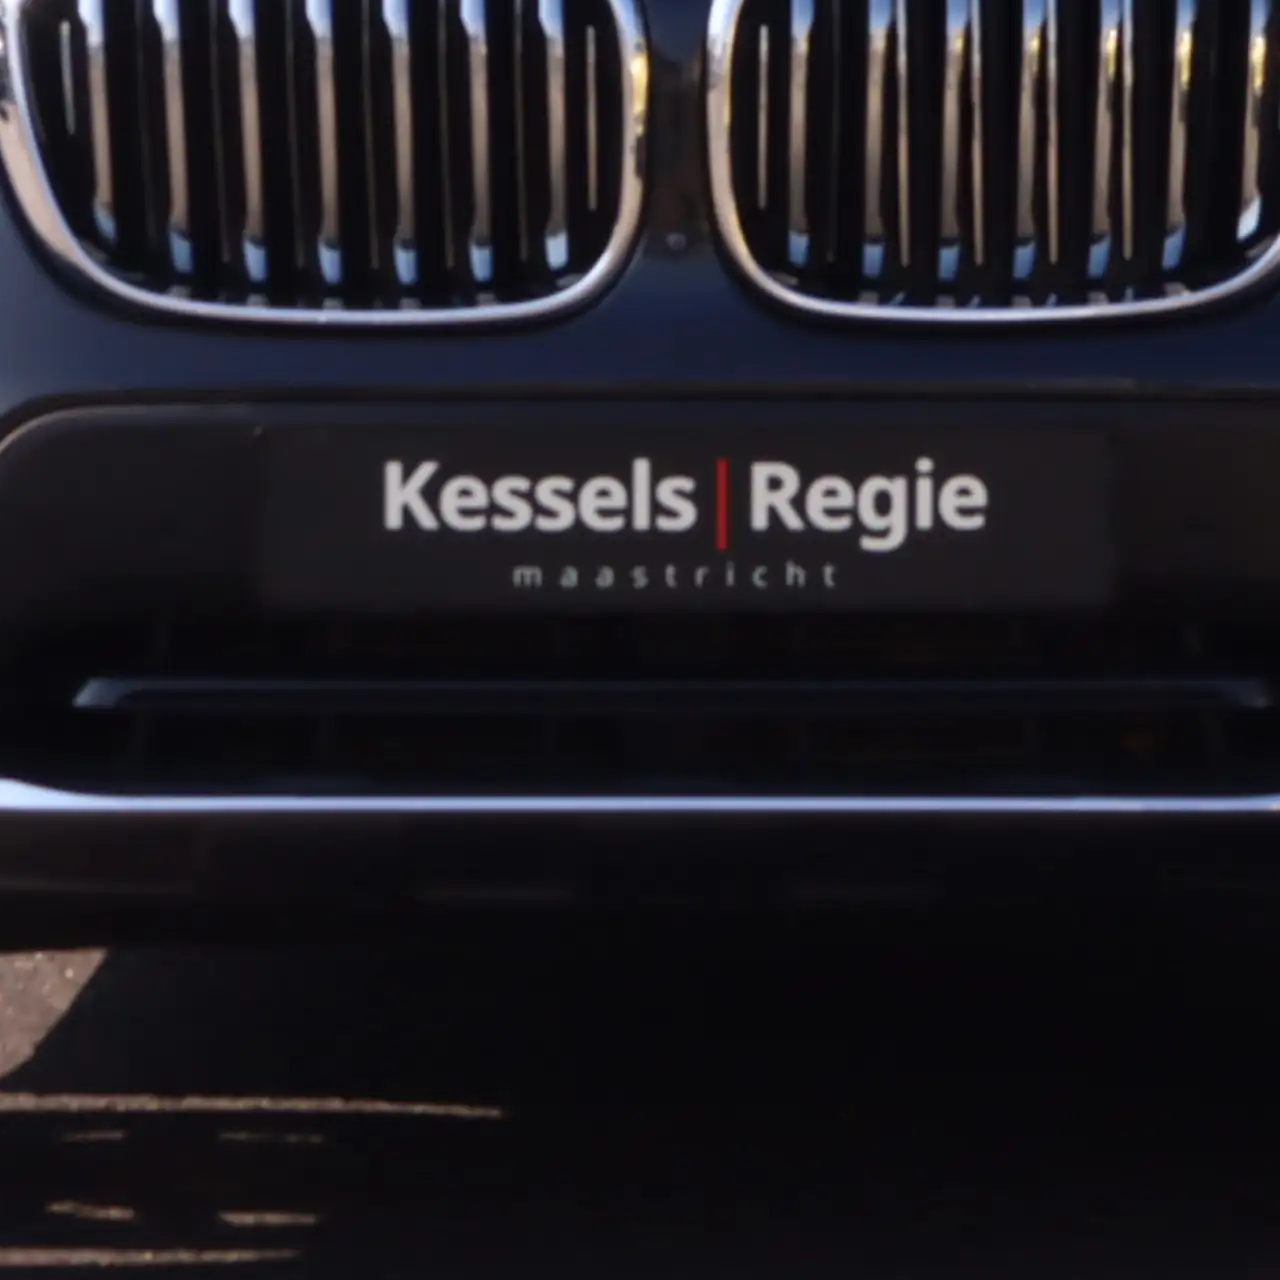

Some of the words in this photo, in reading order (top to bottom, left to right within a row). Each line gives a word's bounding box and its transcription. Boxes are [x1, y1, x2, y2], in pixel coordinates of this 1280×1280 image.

[383, 457, 699, 532] Kessels
[750, 456, 990, 552] Regie
[512, 561, 839, 589] maastricht
